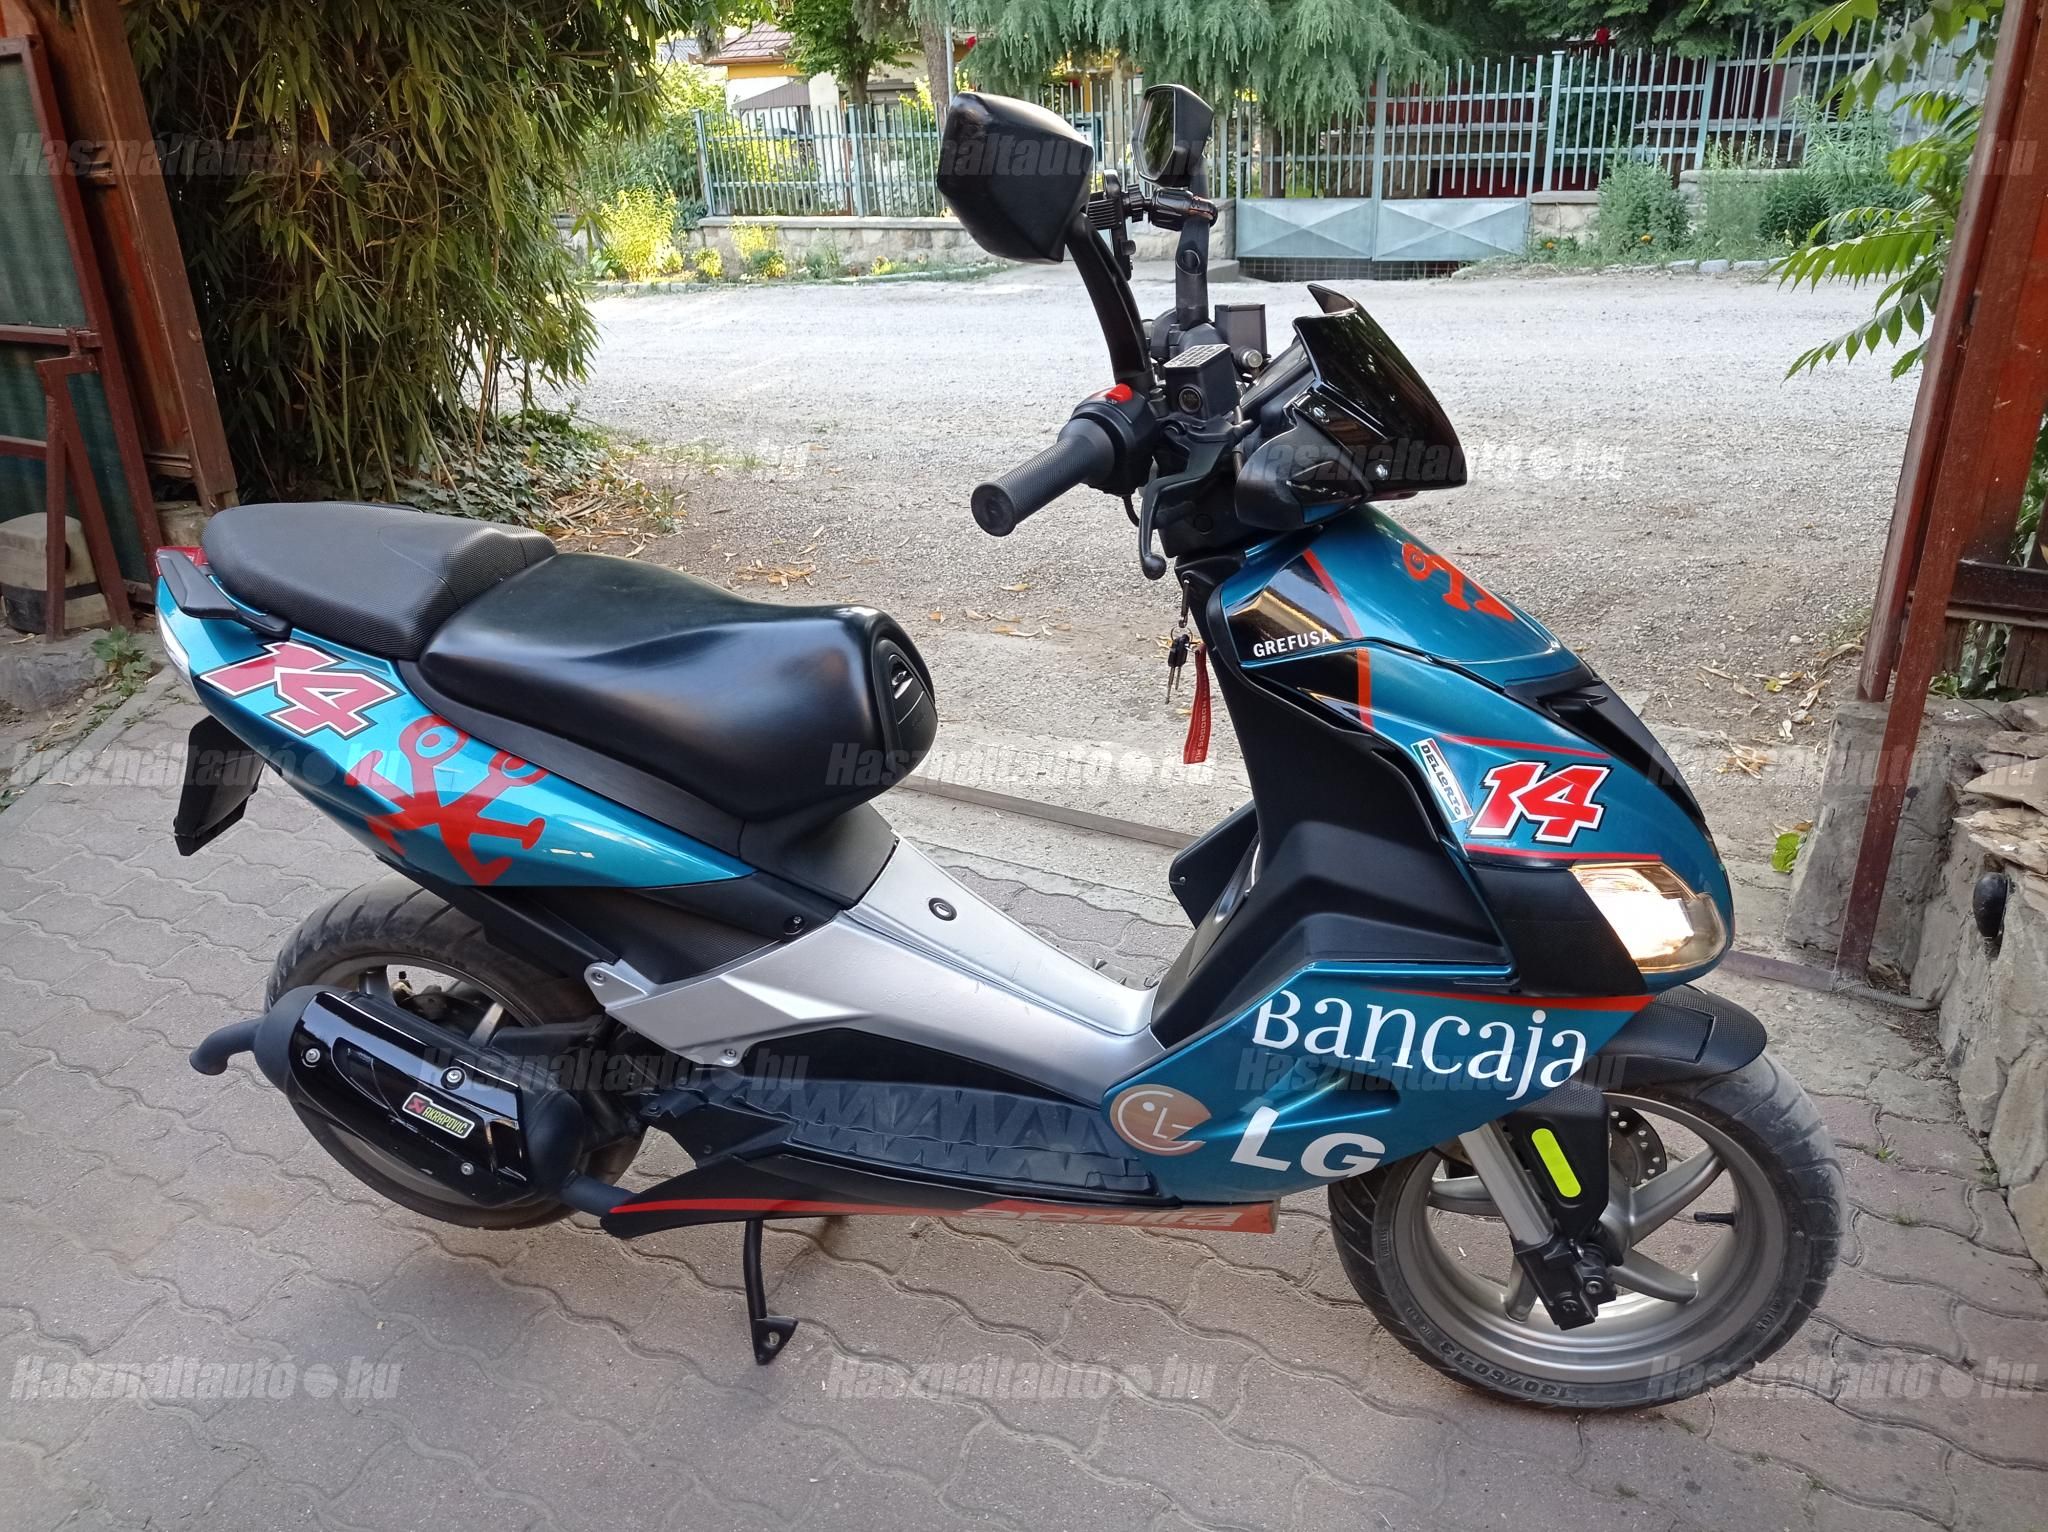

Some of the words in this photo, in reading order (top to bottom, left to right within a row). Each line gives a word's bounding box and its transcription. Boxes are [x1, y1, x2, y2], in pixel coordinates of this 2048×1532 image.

[1252, 629, 1333, 658] GREFUSA
[201, 641, 398, 737] 14
[1467, 761, 1611, 844] 14
[1252, 990, 1587, 1101] Bancaja
[1230, 1106, 1387, 1178] LG
